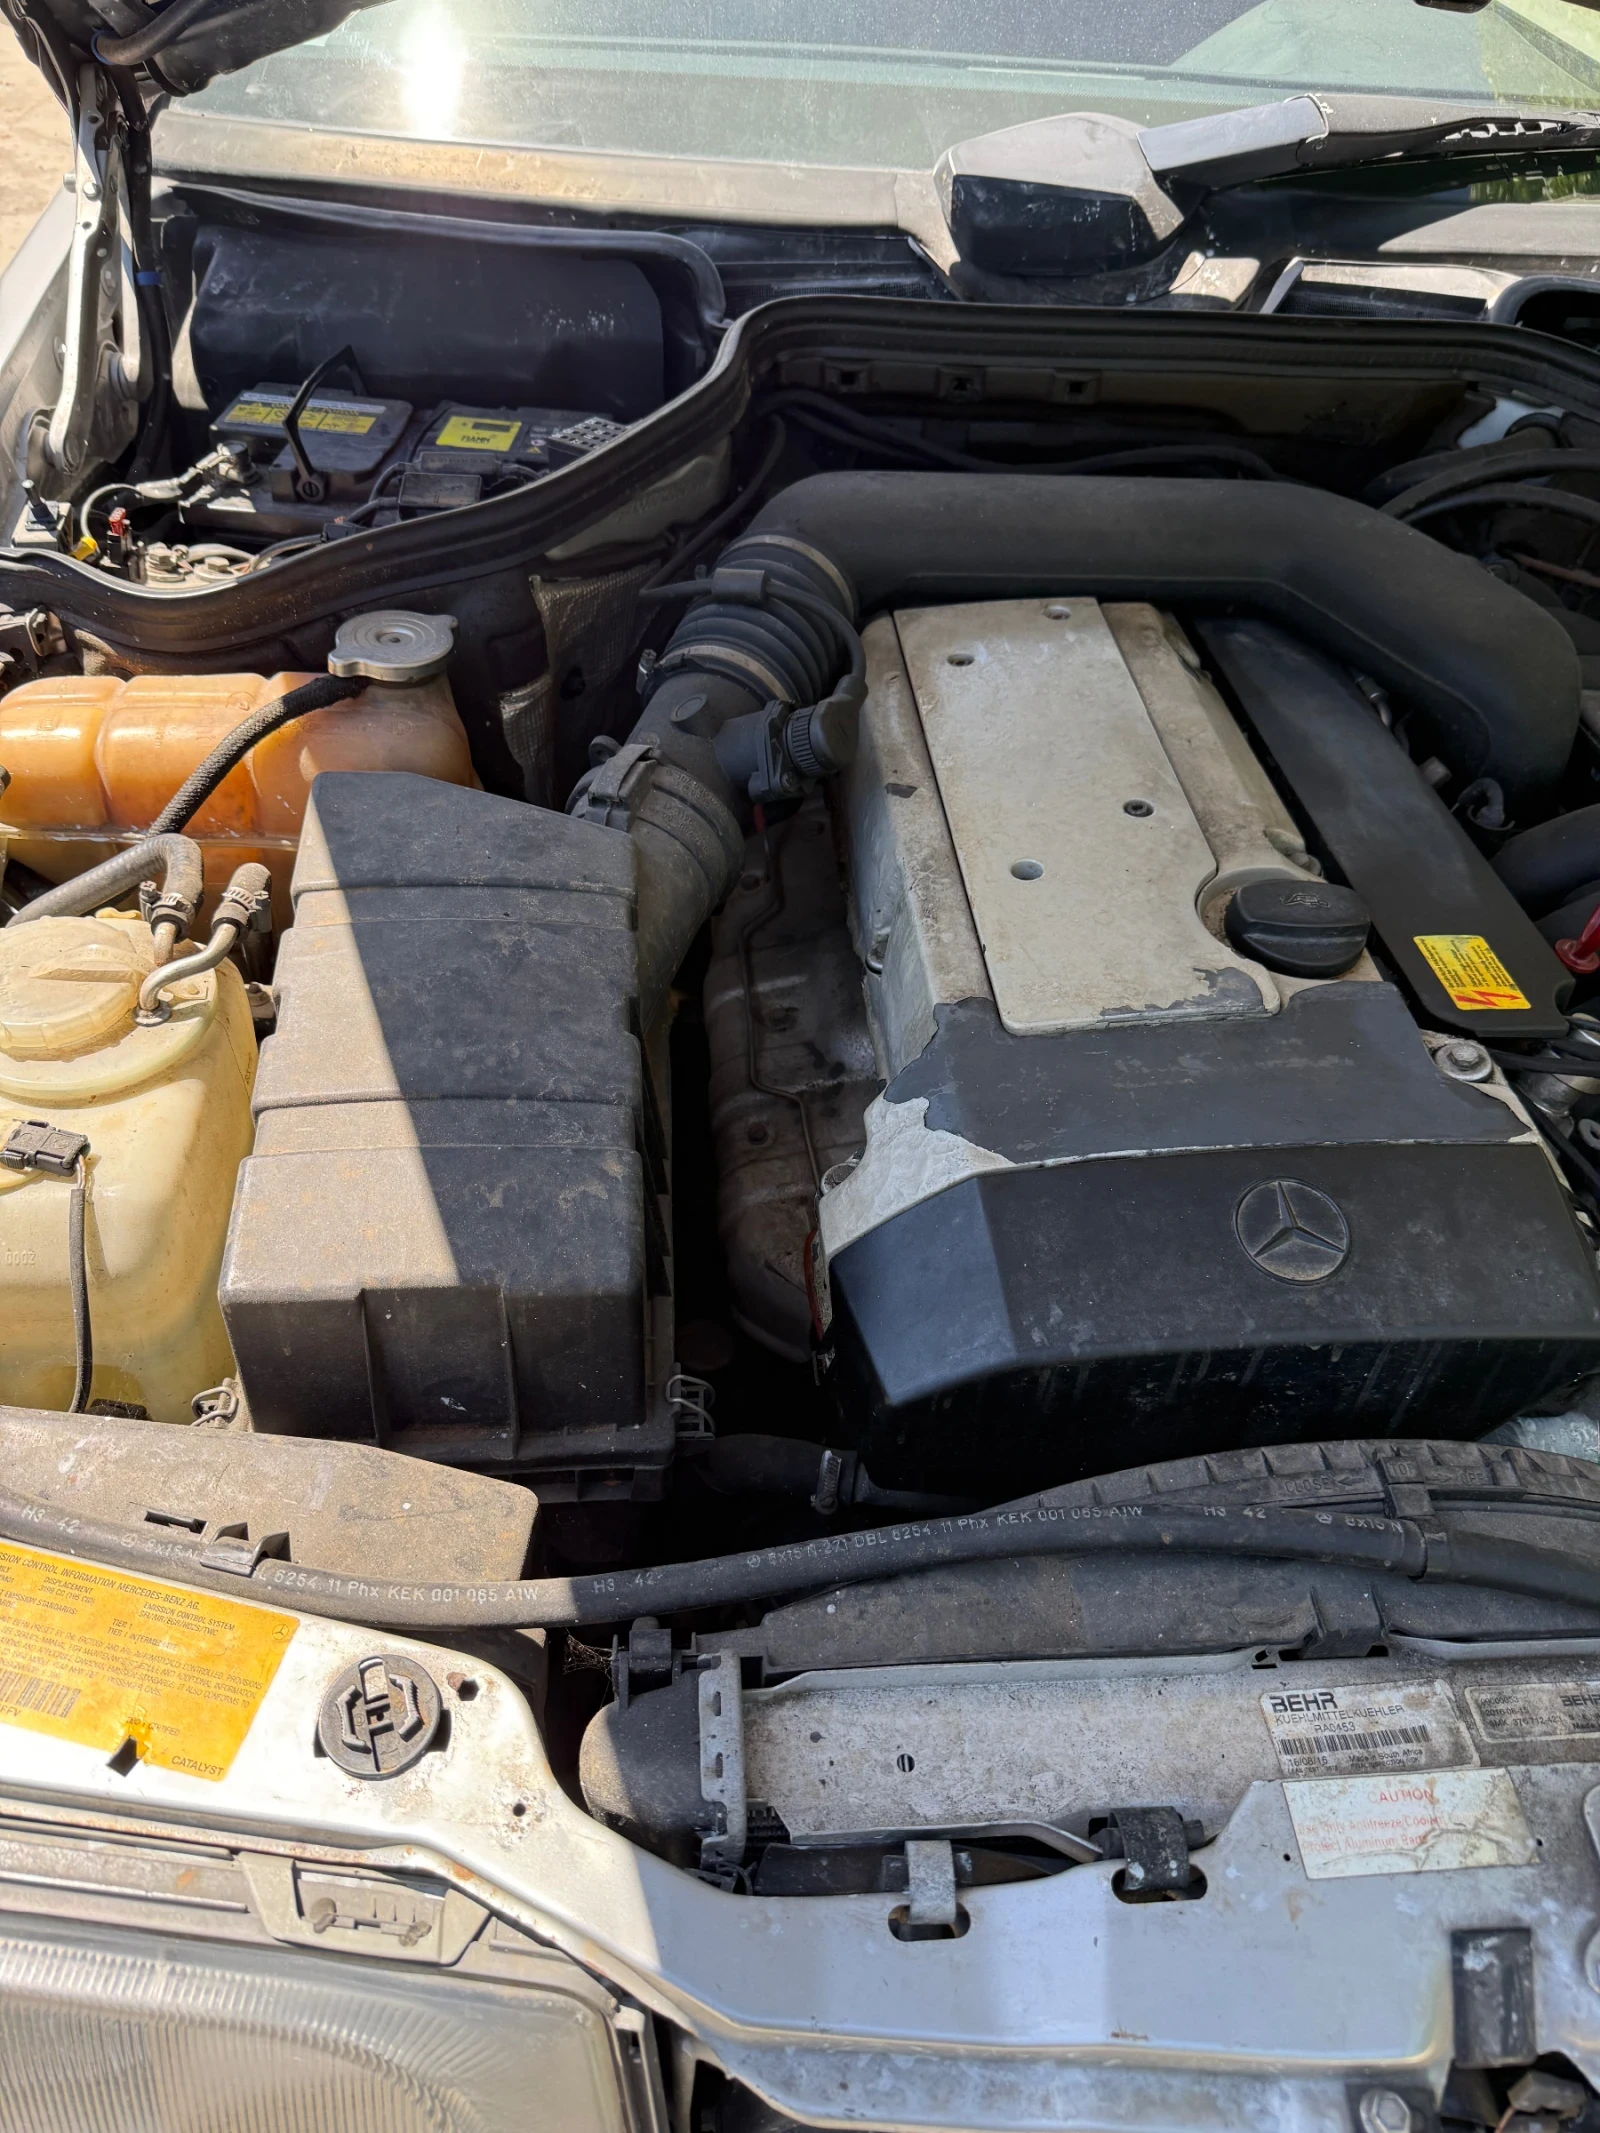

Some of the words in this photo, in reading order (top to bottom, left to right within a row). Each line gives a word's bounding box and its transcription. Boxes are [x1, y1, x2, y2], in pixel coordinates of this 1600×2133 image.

[1284, 1477, 1332, 1493] CLOSE
[22, 1506, 46, 1522] H3
[58, 1517, 80, 1534] 42
[347, 1580, 380, 1598] Phx
[388, 1586, 425, 1600] KEK
[593, 1577, 616, 1593] H3
[633, 1571, 658, 1587] 42
[853, 1534, 888, 1547] DBL
[997, 1511, 1034, 1527] KEK
[1037, 1508, 1066, 1522] 001
[1203, 1504, 1227, 1518] H3
[1242, 1504, 1267, 1519] 42
[22, 1559, 59, 1575] CONTROL
[61, 1568, 116, 1588] INFORMATION
[118, 1582, 187, 1607] MERCEDES-BENZ
[43, 1576, 94, 1595] DISPLACEMENT
[143, 1602, 176, 1616] EMISSION
[176, 1610, 206, 1624] CONTROL
[207, 1618, 236, 1631] SYSTEM
[226, 1673, 263, 1690] PROVISIONS
[240, 1700, 250, 1709] TO
[1268, 1691, 1338, 1713] BEHR
[1314, 1721, 1356, 1734] RA0453
[1379, 1751, 1400, 1760] South
[1402, 1748, 1423, 1756] Africa
[171, 1755, 224, 1777] CATALYST
[1367, 1787, 1434, 1804] CAUTION
